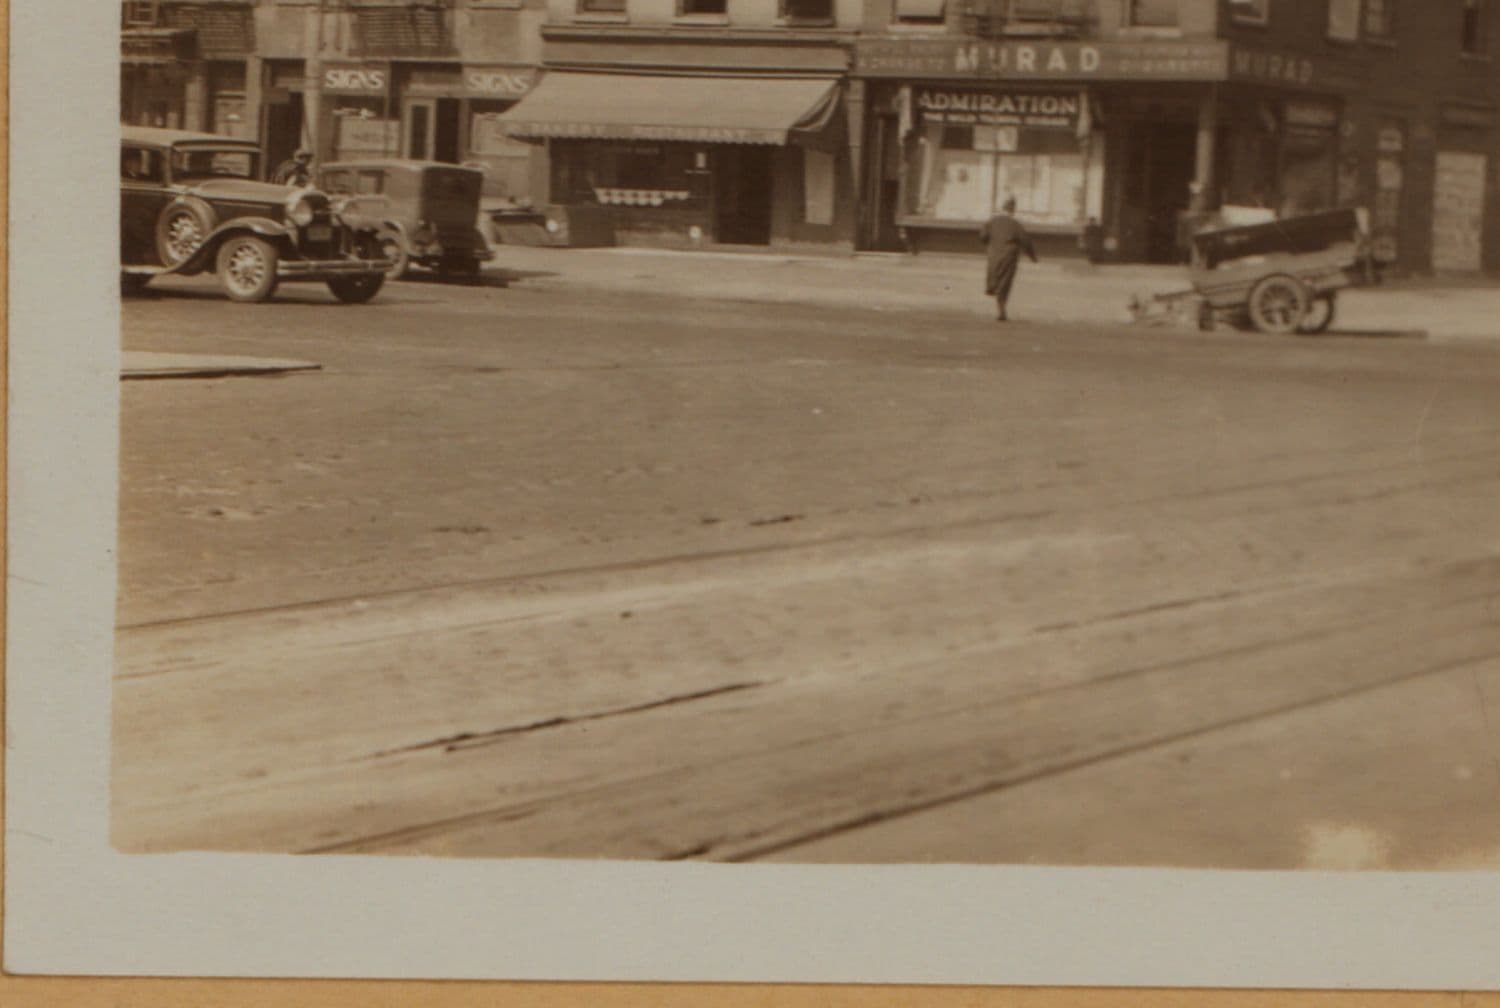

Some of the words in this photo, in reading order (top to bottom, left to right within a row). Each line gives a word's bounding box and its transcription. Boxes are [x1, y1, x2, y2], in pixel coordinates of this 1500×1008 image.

[954, 46, 1100, 74] MURAD
[1234, 50, 1313, 85] MURAD
[918, 93, 1076, 115] ADMIRATION
